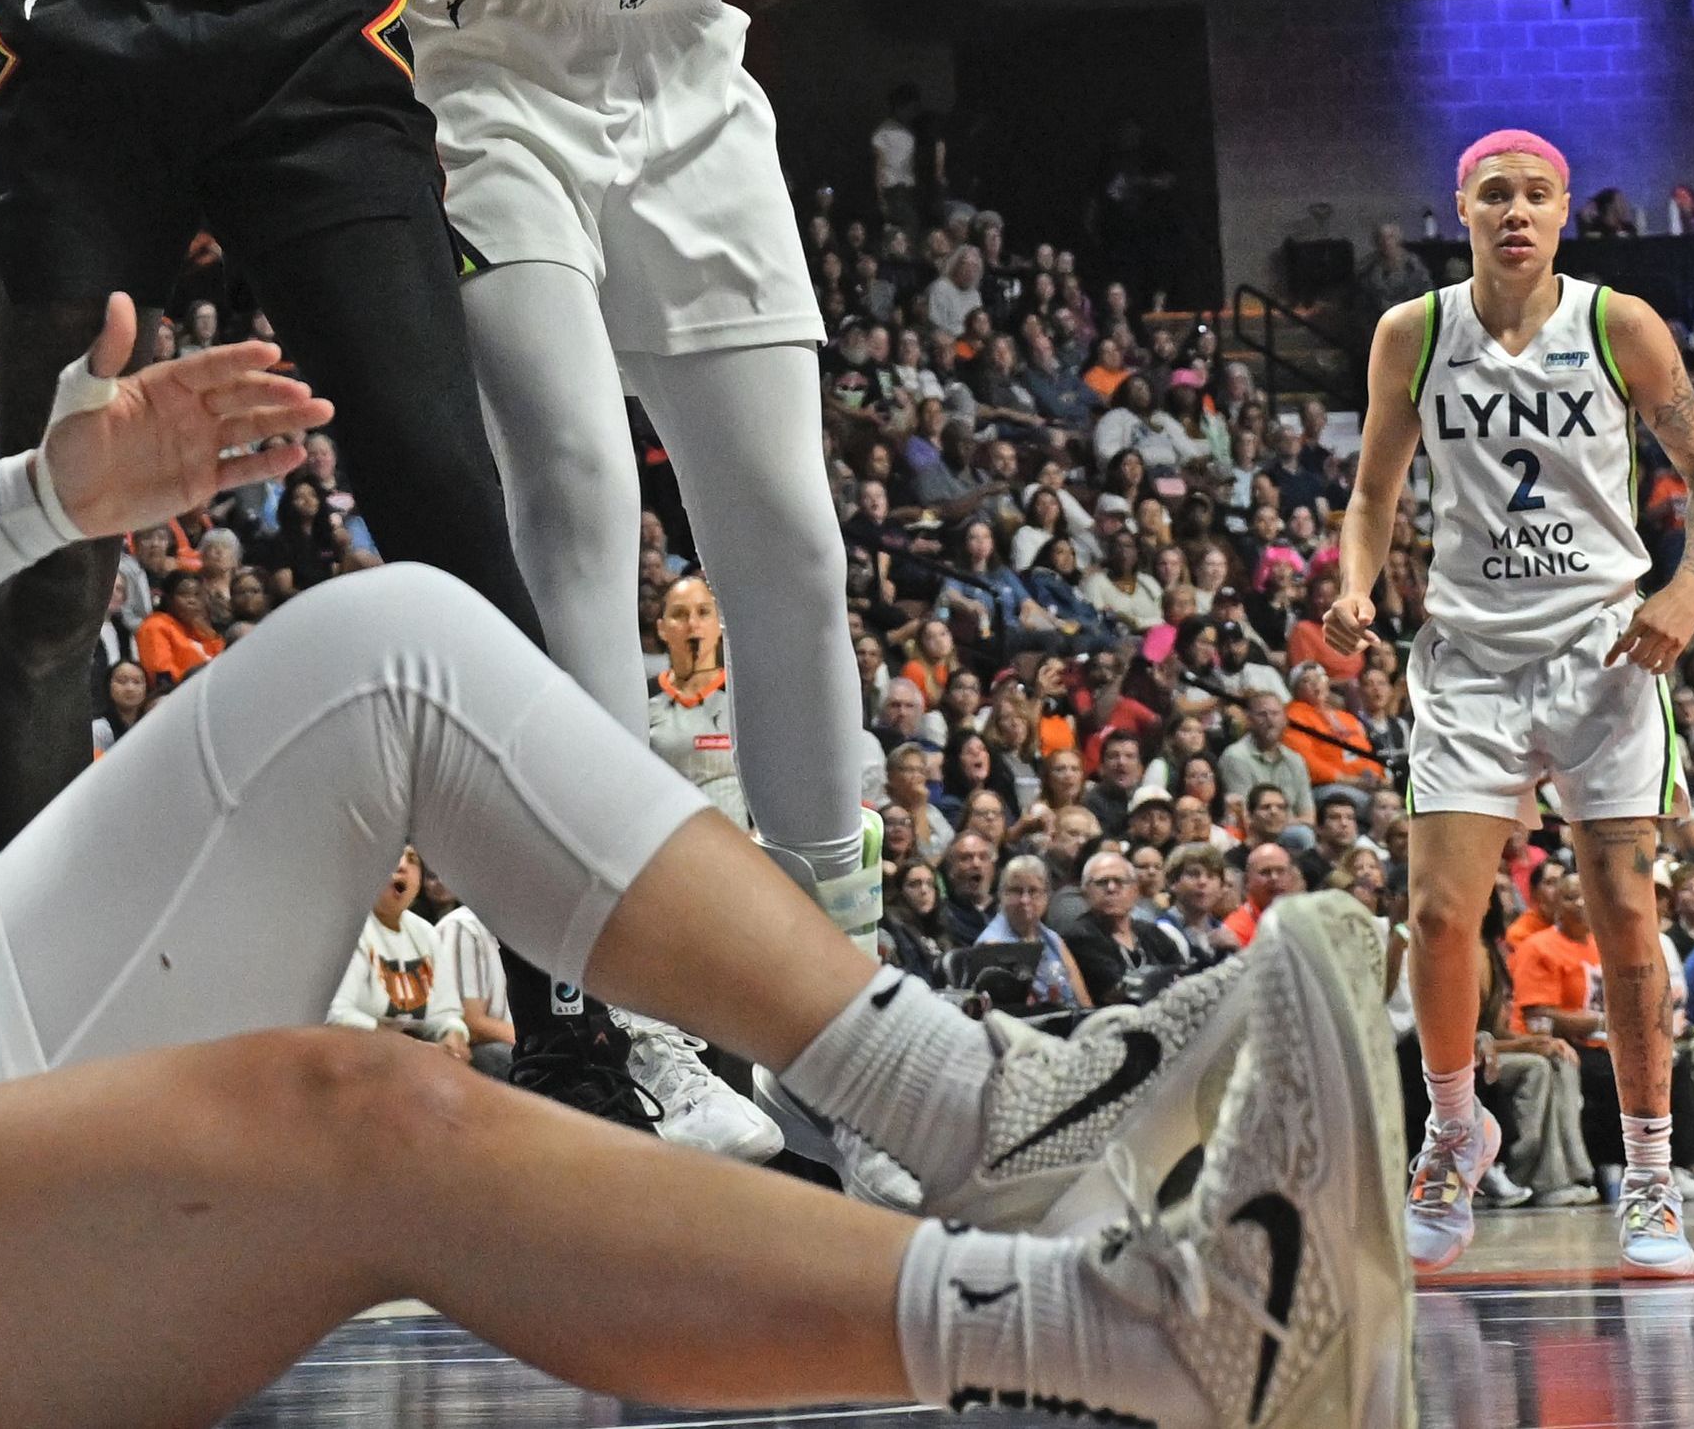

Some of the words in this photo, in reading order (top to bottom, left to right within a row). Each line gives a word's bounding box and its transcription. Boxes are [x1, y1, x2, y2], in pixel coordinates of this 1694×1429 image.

[1435, 390, 1596, 440] LYNX
[1504, 449, 1546, 512] 2
[1488, 521, 1574, 551] MAYO
[1481, 550, 1590, 581] CLINIC
